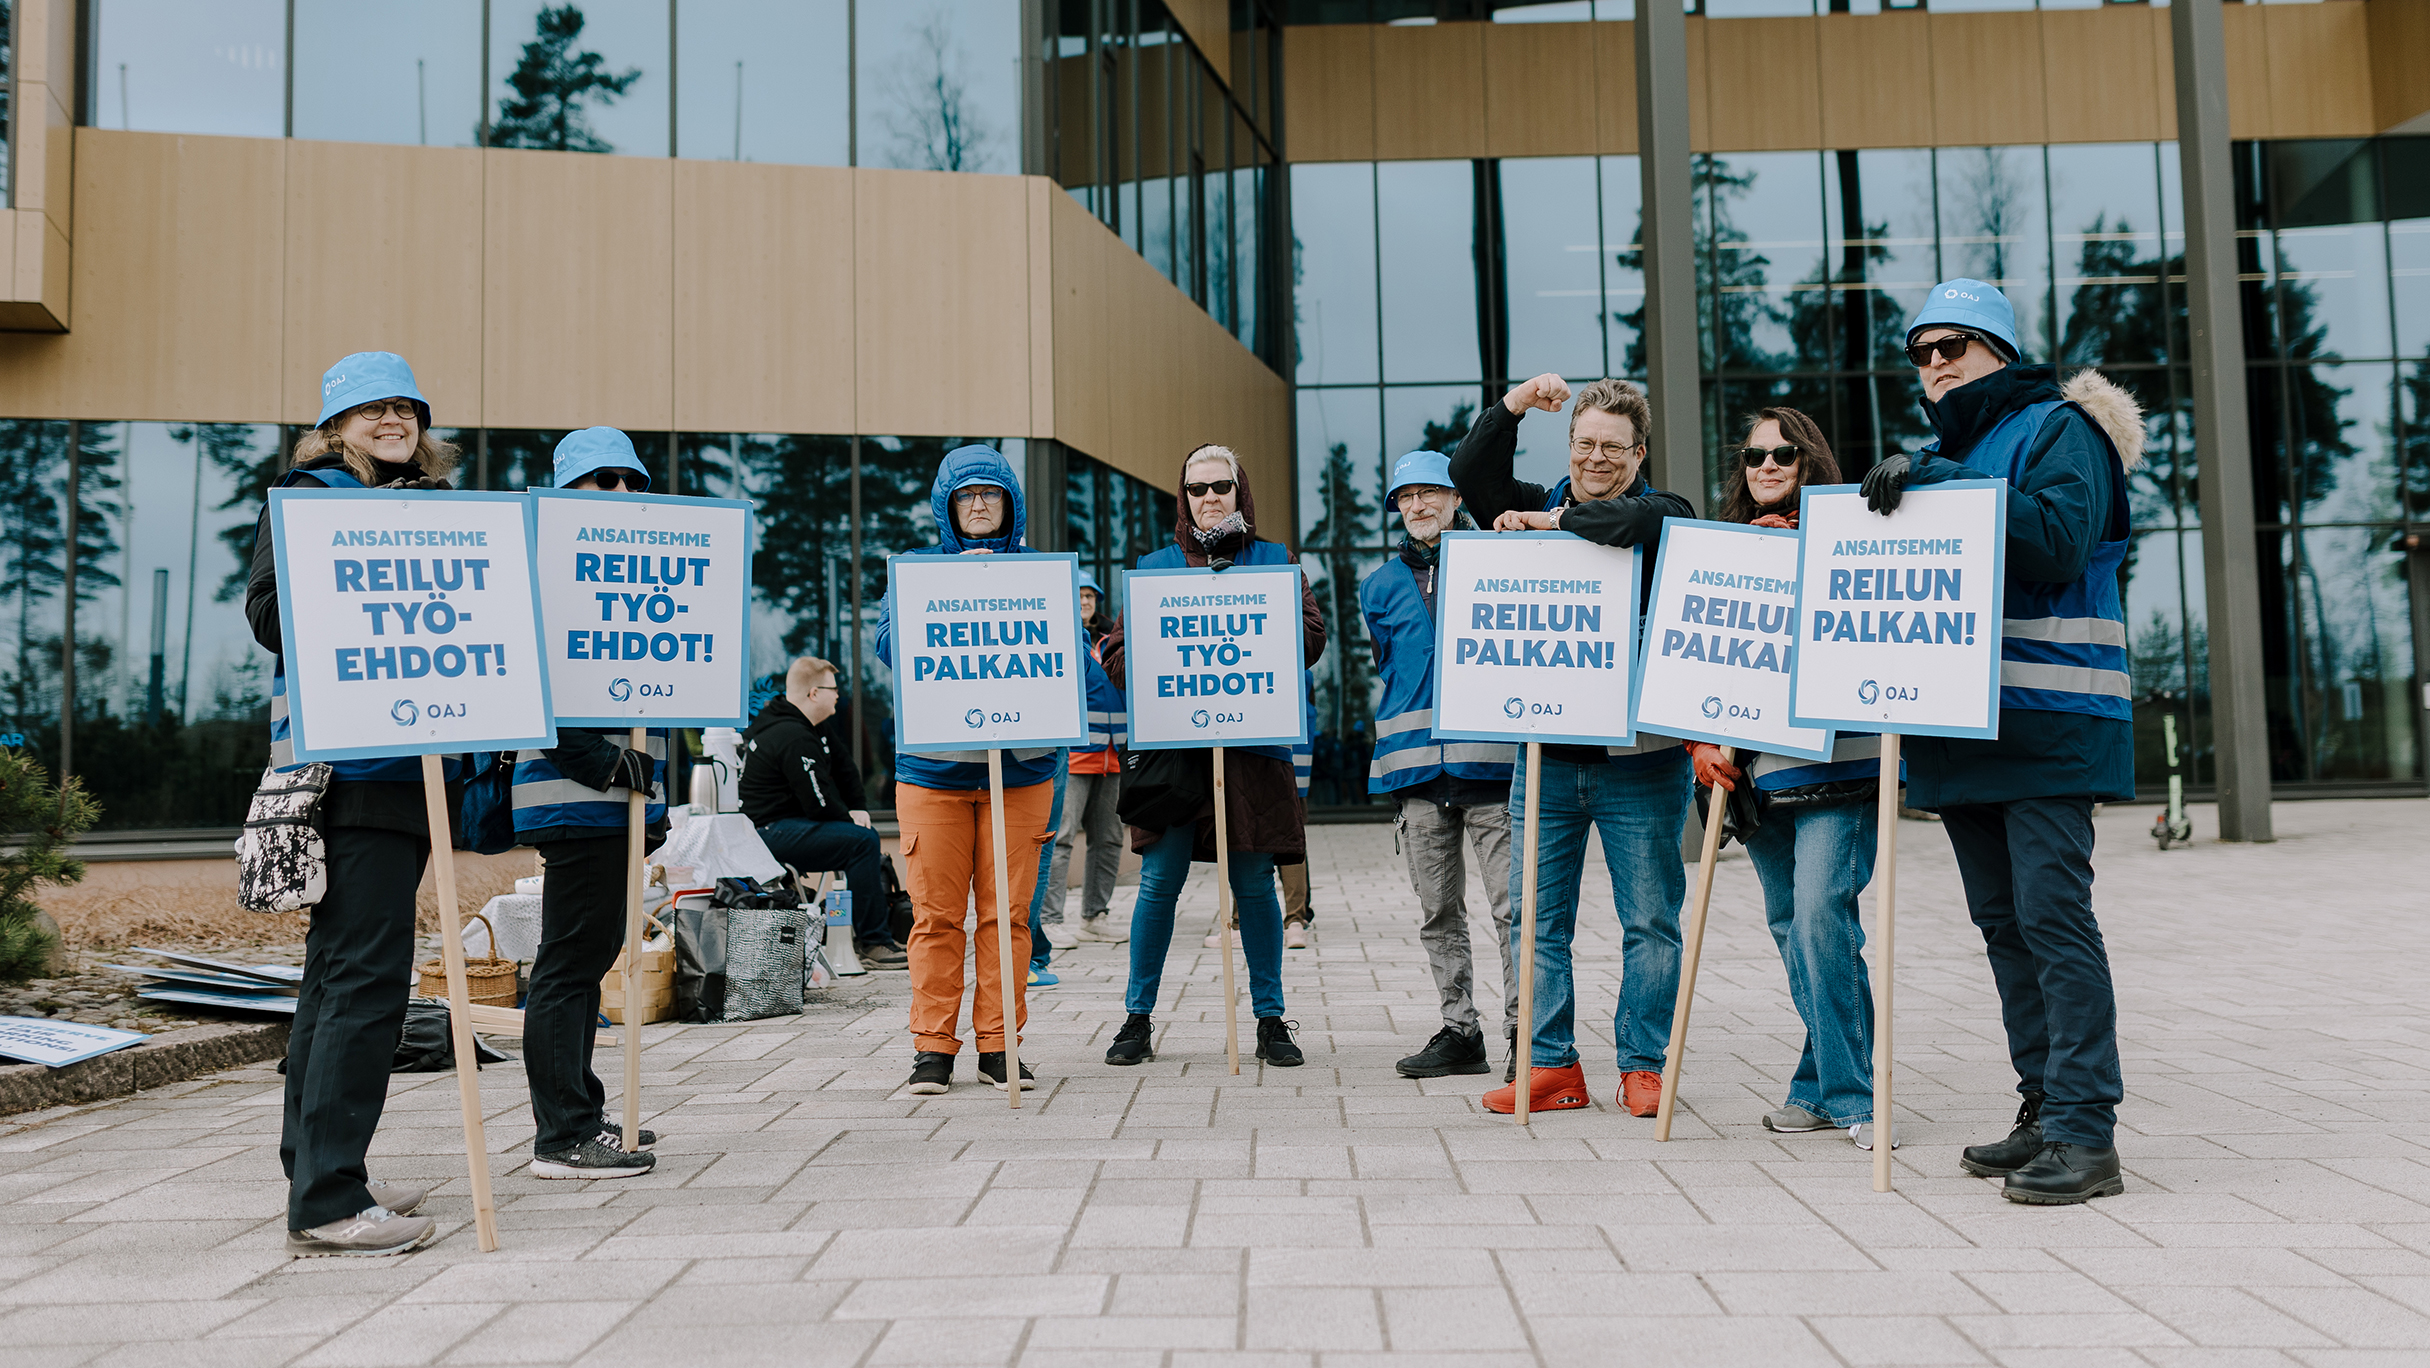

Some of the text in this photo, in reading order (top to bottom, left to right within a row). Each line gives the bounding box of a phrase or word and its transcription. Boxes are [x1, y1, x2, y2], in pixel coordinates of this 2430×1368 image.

[1960, 291, 1980, 302] OAJ
[331, 374, 346, 387] OAJ
[332, 530, 487, 546] ANSAITSEMME
[576, 527, 710, 547] ANSAITSEMME
[1832, 539, 1962, 556] ANSAITSEMME
[334, 559, 490, 592] REILUT
[576, 553, 710, 586] REILUT
[1474, 579, 1601, 594] ANSAITSEMME
[1688, 570, 1796, 596] ANSAITSEM
[1829, 569, 1961, 601] REILUN
[362, 592, 472, 635] TYÖ-
[595, 586, 688, 623] TYÖ-
[926, 598, 1046, 612] ANSAITSEMME
[1160, 594, 1267, 608] ANSAITSEMME
[1160, 613, 1267, 638] REILUT
[1472, 603, 1601, 632] REILUN
[1813, 610, 1976, 645] PALKAN!
[926, 620, 1049, 647] REILUN
[567, 630, 713, 663] EHDOT!
[1177, 637, 1252, 667] TYÖ-
[1456, 638, 1615, 669] PALKAN!
[1662, 629, 1792, 674] PALKA
[335, 644, 506, 681] EHDOT!
[914, 652, 1064, 681] PALKAN!
[640, 684, 673, 697] OAJ
[1157, 672, 1274, 698] EHDOT!
[1886, 686, 1918, 701] OAJ
[427, 703, 466, 718] OAJ
[991, 712, 1020, 723] OAJ
[1216, 713, 1243, 723] OAJ
[1531, 703, 1562, 715] OAJ
[1729, 705, 1760, 720] OAJ
